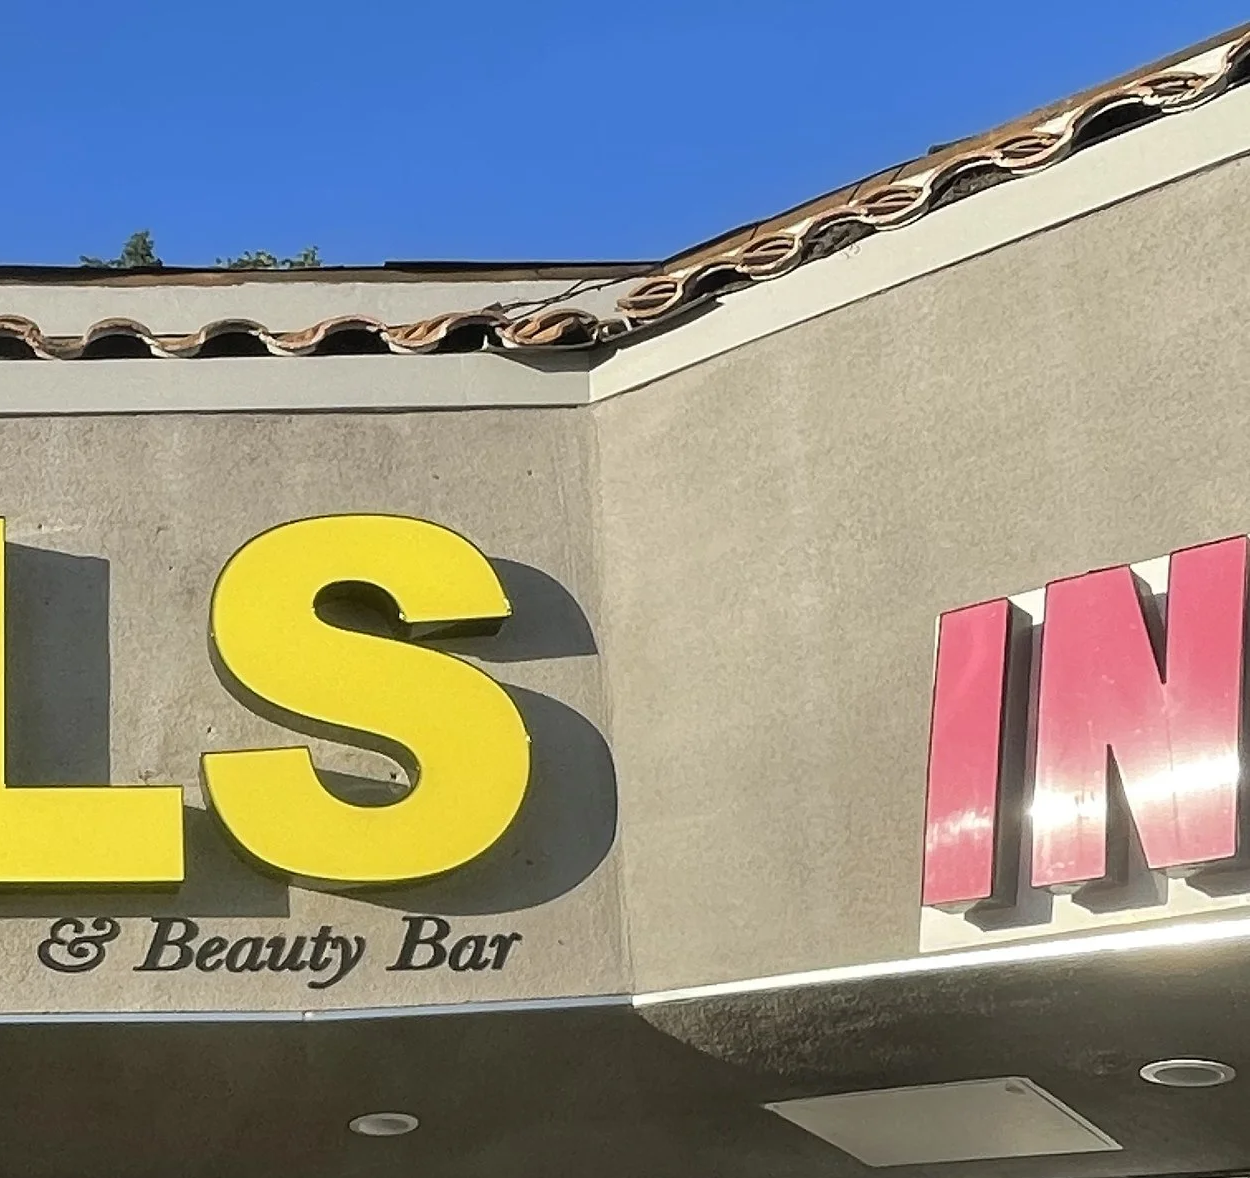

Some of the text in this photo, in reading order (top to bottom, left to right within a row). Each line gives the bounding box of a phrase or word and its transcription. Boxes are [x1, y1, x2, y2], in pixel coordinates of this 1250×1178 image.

[922, 535, 1247, 906] IN
[37, 915, 523, 990] & Beauty Bar
